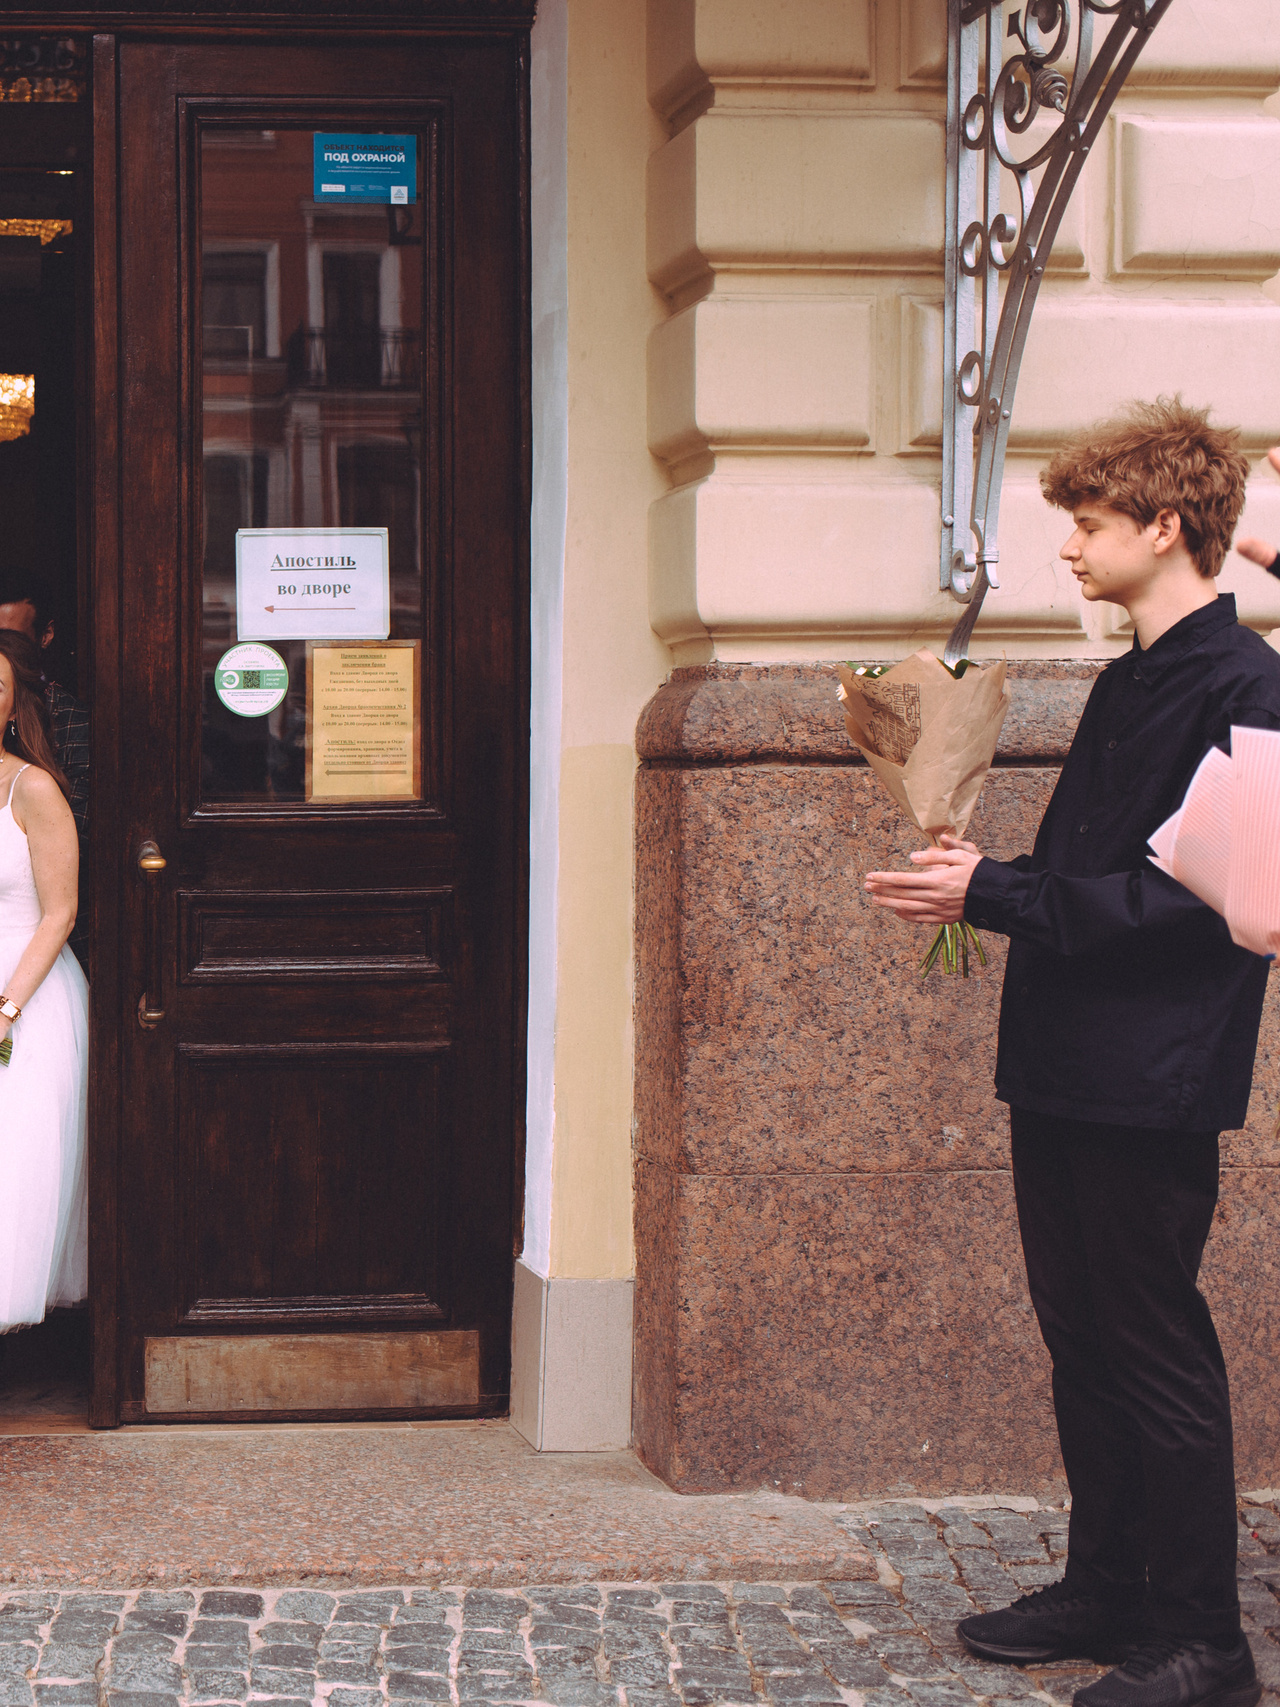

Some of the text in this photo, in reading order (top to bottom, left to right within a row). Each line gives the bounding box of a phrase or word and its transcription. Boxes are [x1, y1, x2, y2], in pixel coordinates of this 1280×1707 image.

[356, 144, 405, 152] НАХОДИТСЯ
[324, 152, 406, 163] ПОД ОХРАНОЙ
[270, 553, 357, 569] Апостиль
[277, 583, 352, 598] во дворе
[222, 646, 281, 668] УЧАСТНИК ПРОЕКТА
